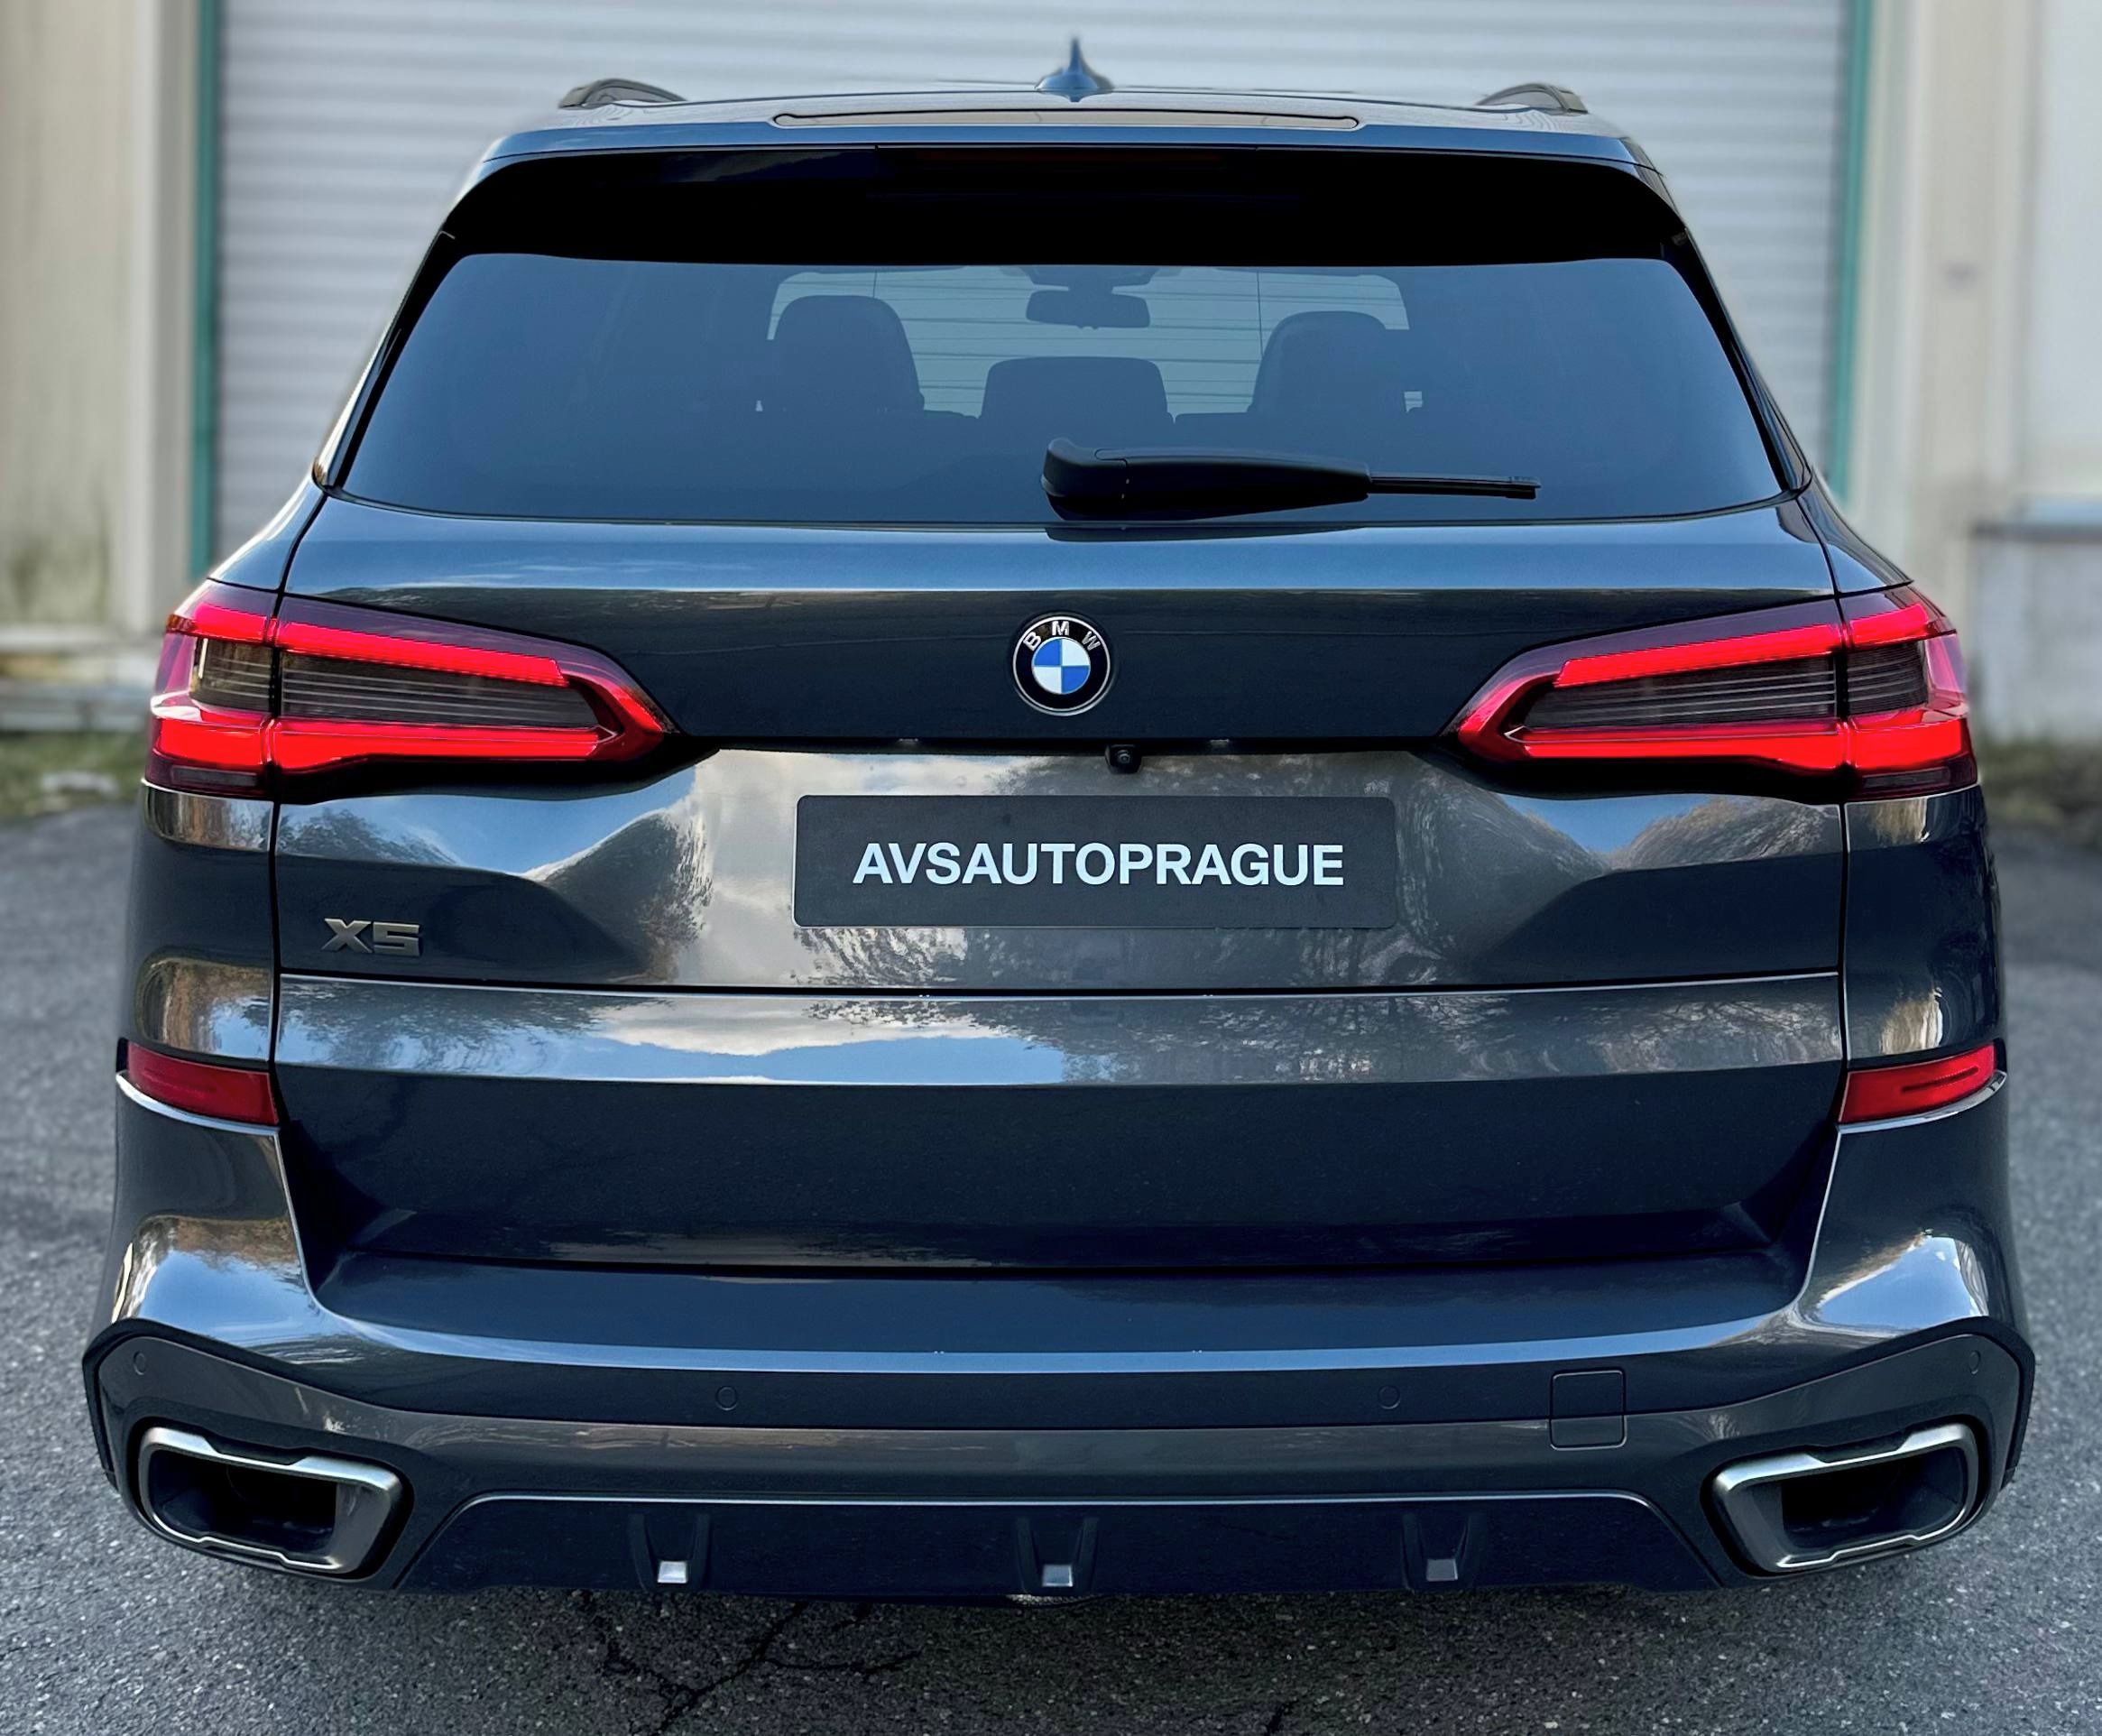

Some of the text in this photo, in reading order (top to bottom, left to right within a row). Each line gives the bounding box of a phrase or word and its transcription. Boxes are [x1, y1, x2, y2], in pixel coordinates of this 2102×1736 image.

[1022, 620, 1102, 651] BMW
[852, 842, 1344, 887] AVSAUTOPRAGUE
[320, 918, 422, 958] X5
